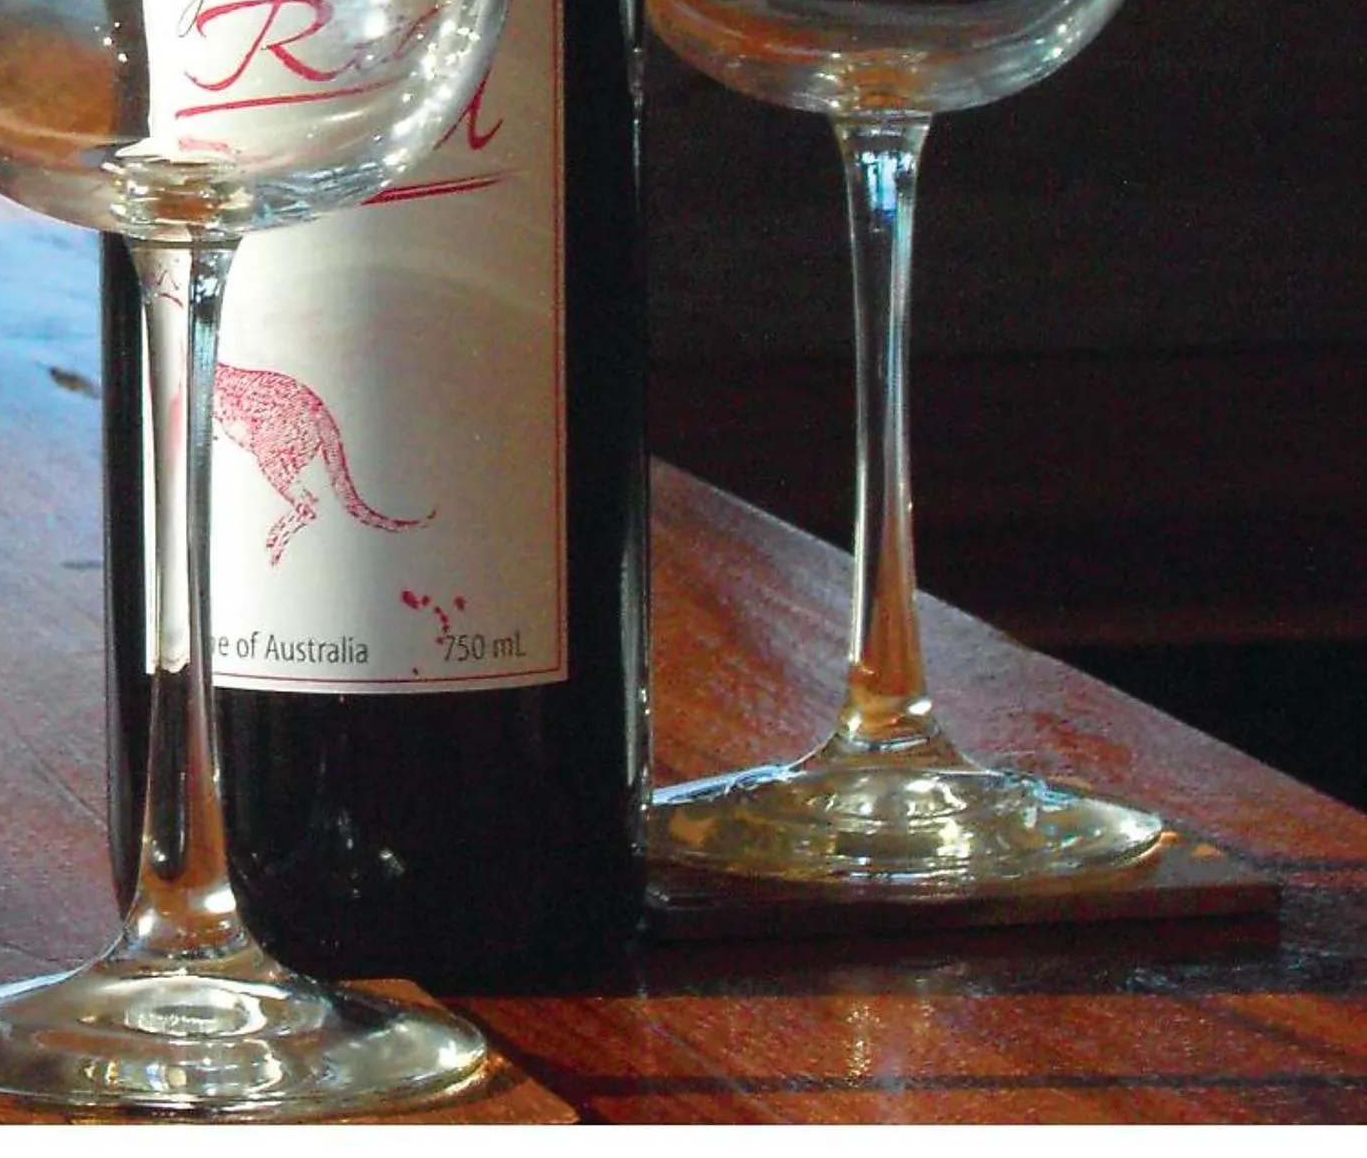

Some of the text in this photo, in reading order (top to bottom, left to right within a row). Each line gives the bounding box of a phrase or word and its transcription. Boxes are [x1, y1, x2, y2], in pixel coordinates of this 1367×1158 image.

[236, 631, 260, 659] of
[265, 634, 369, 664] Australia
[443, 634, 484, 662] 750
